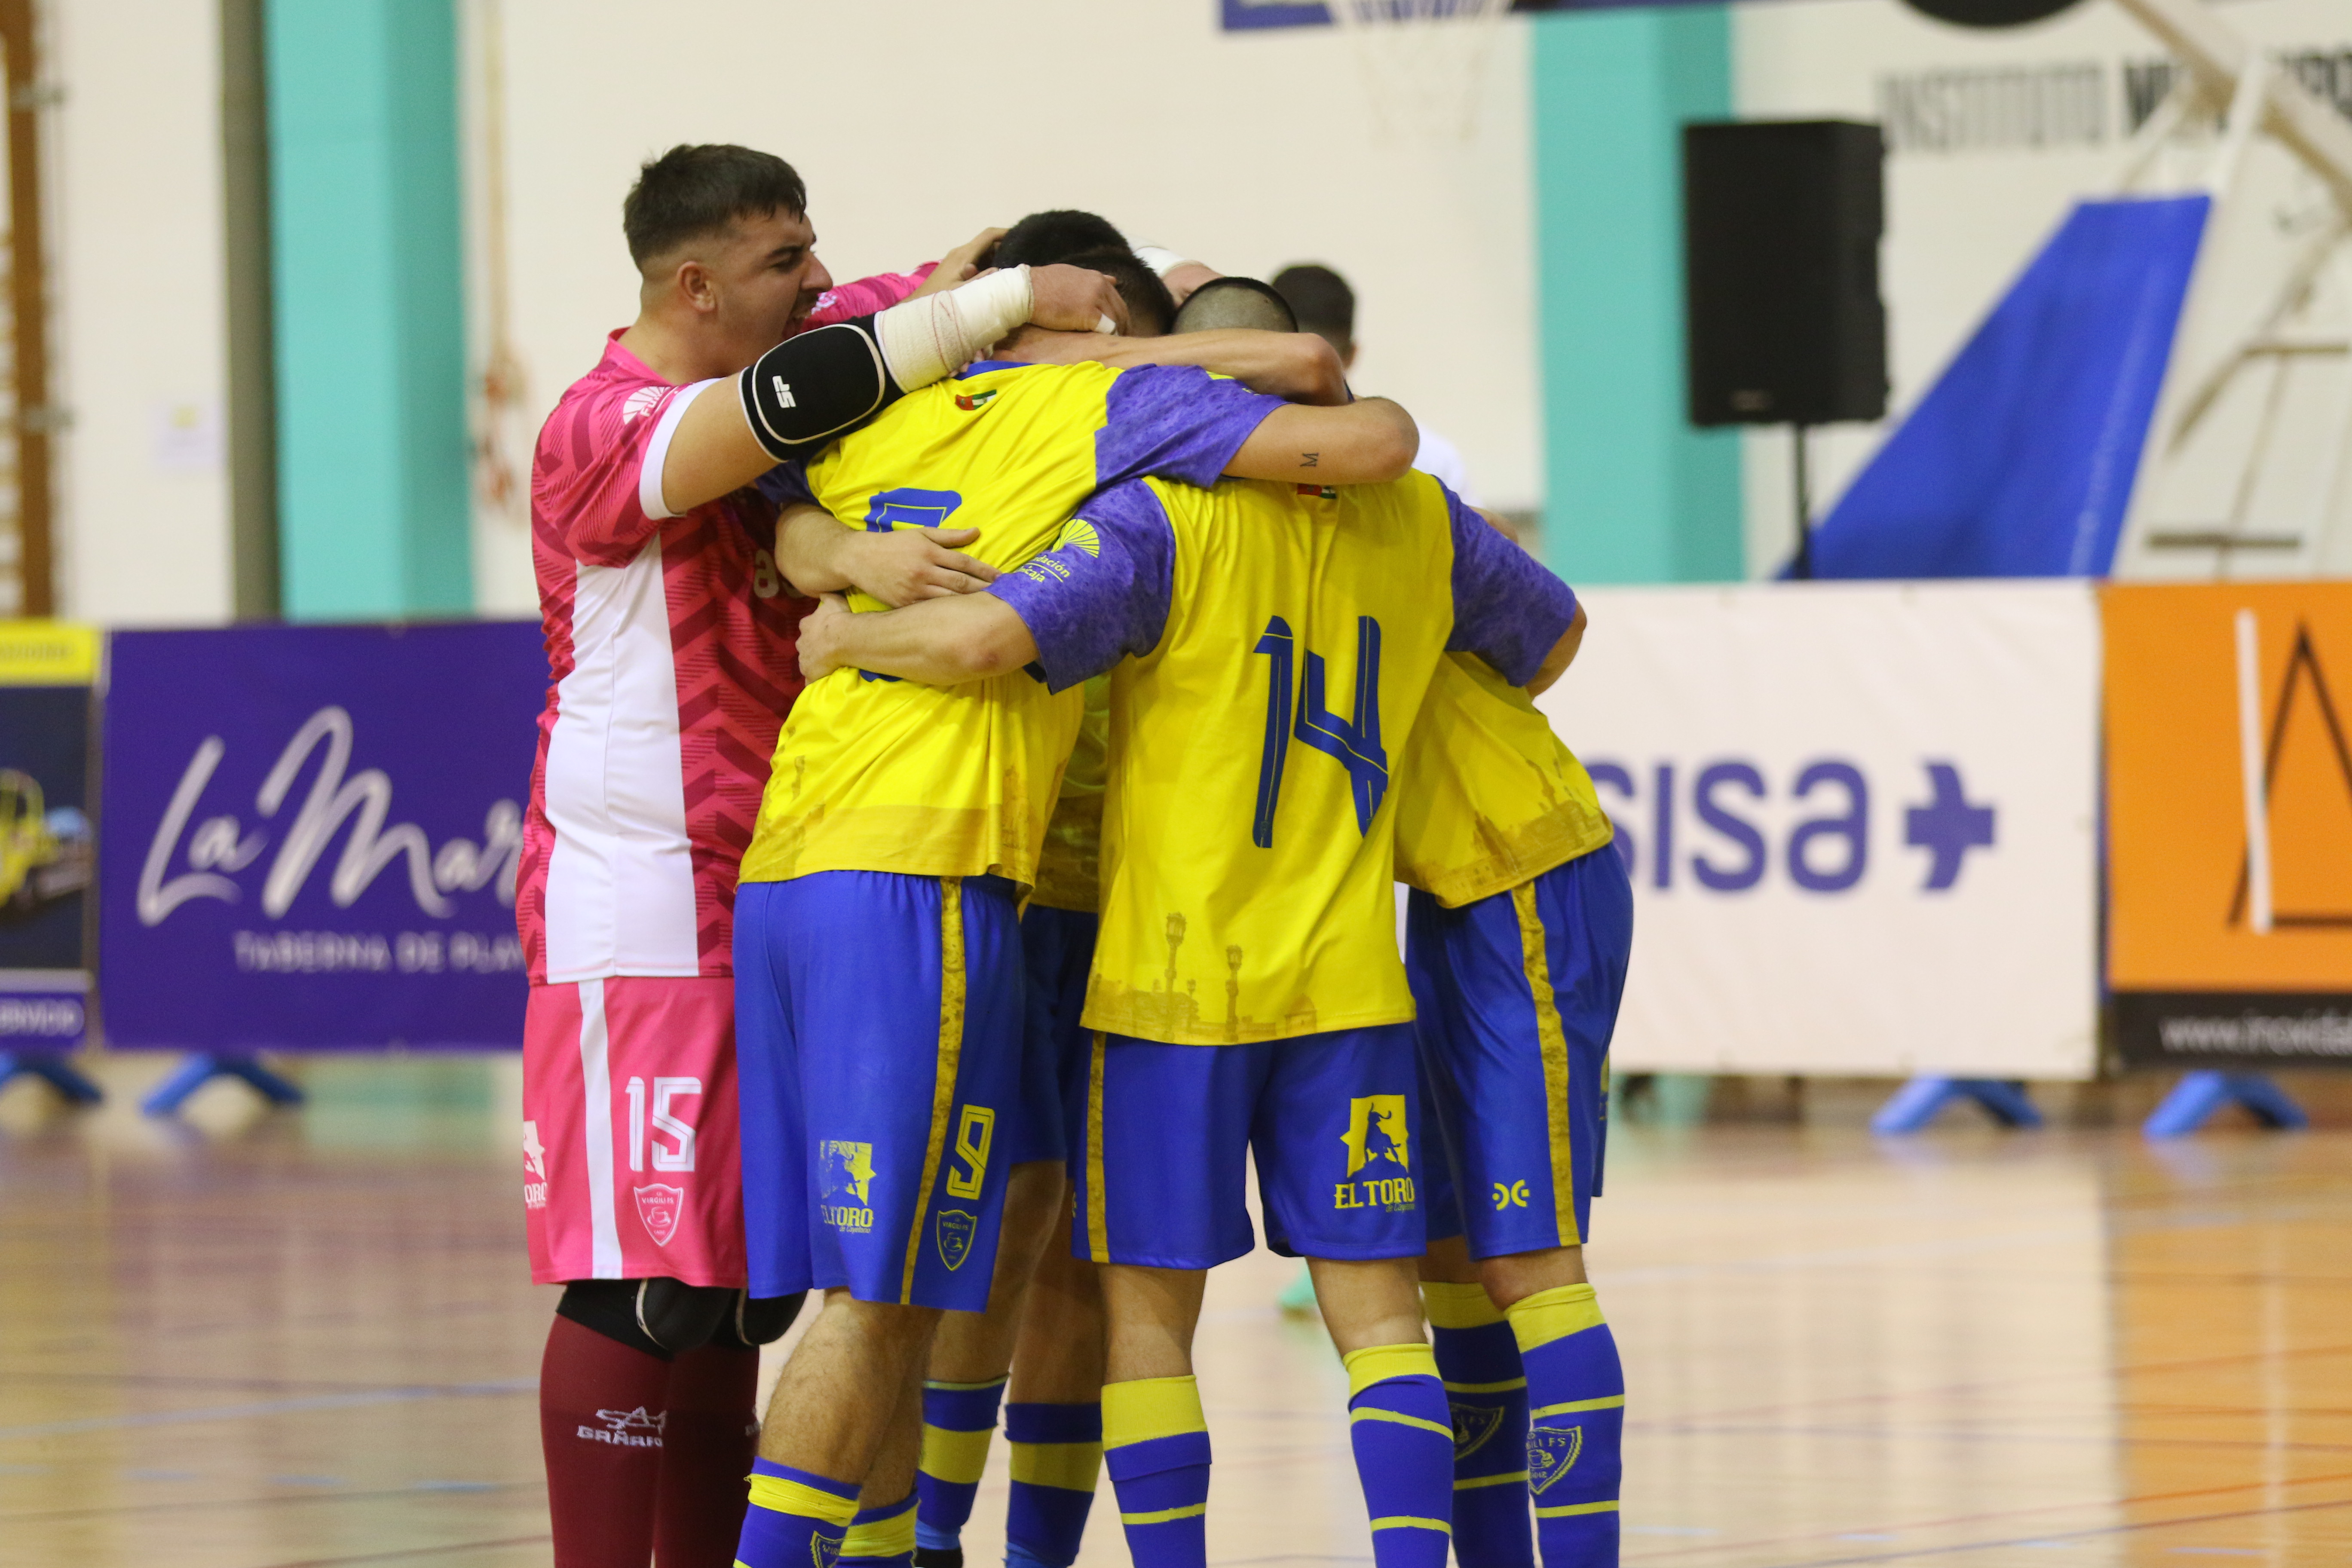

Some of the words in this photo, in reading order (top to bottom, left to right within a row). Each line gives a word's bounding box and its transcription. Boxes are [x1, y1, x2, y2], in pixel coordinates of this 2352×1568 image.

[1253, 615, 1388, 848] 14
[136, 734, 269, 927] La
[232, 930, 393, 973] TABERNA
[395, 931, 447, 973] DE
[626, 1076, 701, 1172] 15
[946, 1104, 995, 1200] 9
[1334, 1183, 1364, 1209] EL
[1363, 1177, 1415, 1206] TORO
[1548, 1437, 1566, 1447] FS
